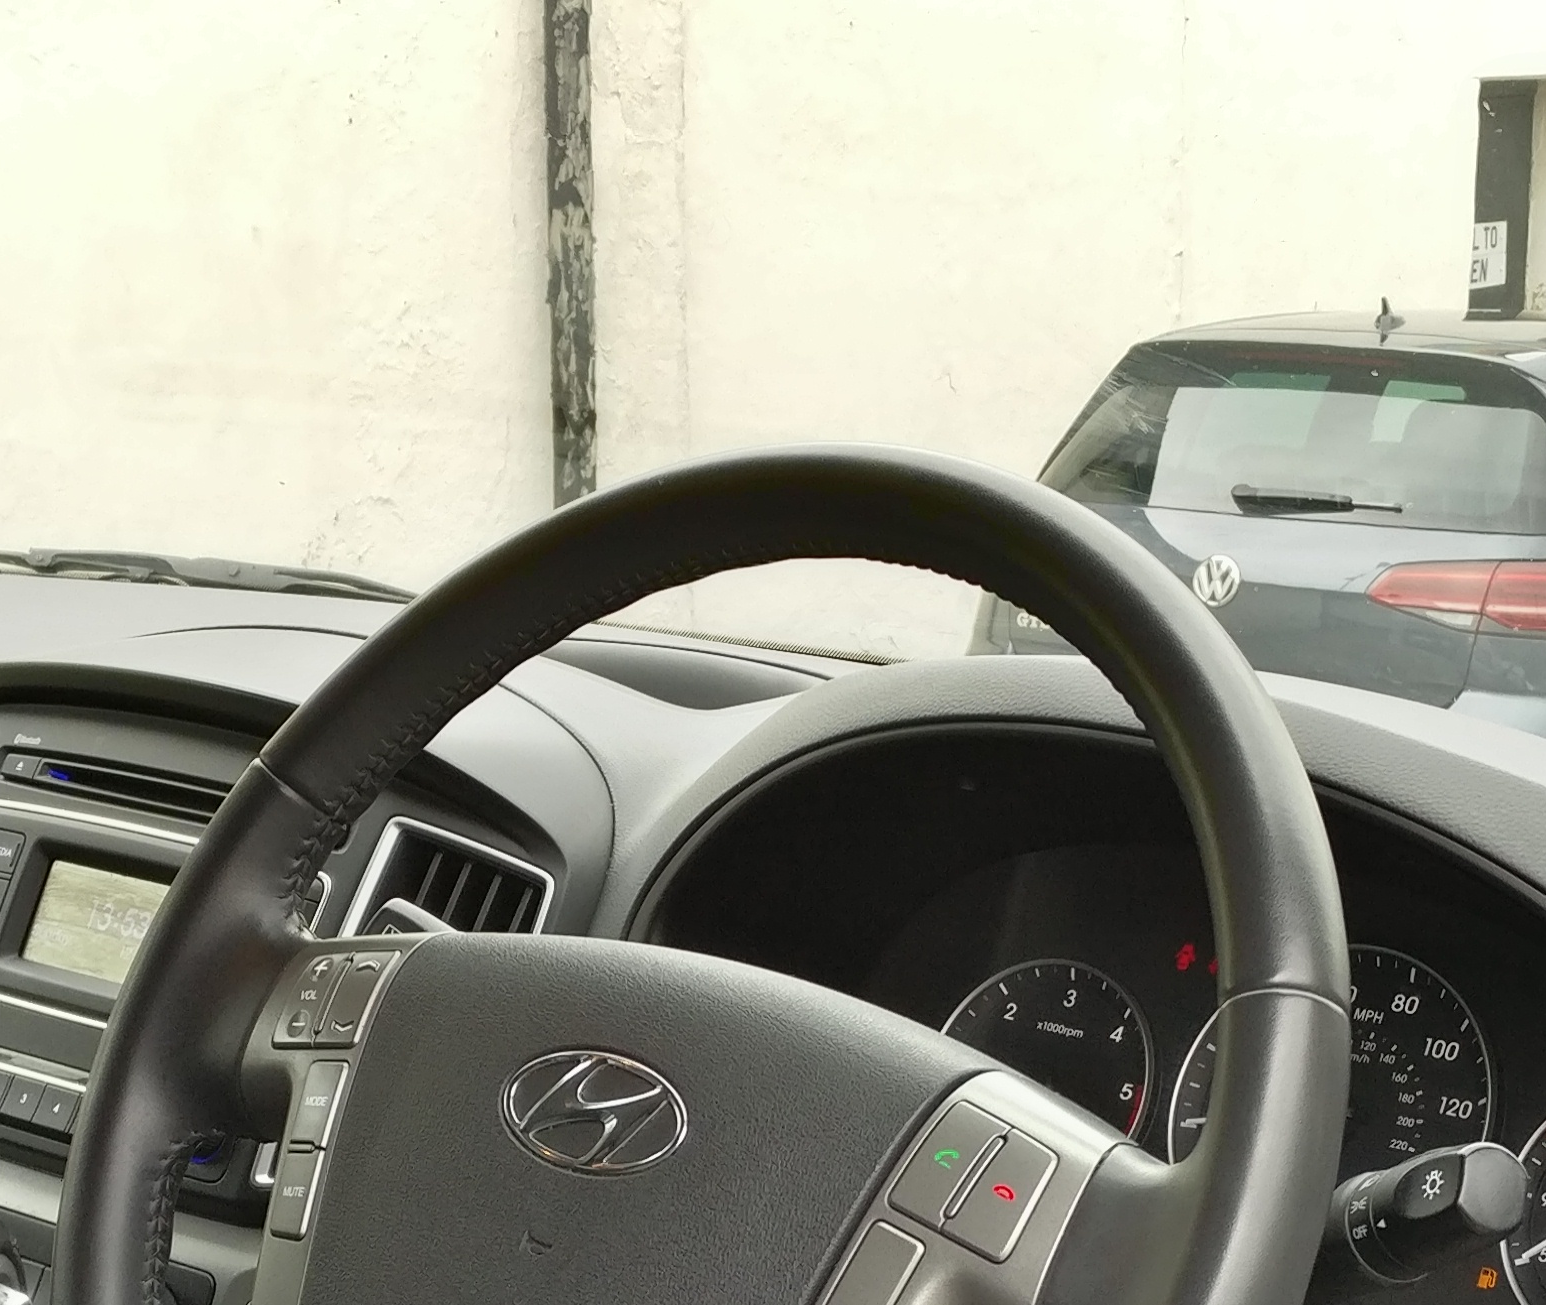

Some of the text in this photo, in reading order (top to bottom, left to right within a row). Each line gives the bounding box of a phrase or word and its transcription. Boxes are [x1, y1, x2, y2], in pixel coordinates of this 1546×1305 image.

[1484, 226, 1498, 250] TO
[299, 989, 319, 1001] VOL
[1062, 989, 1077, 1008] 3
[1390, 993, 1420, 1015] 80
[1003, 1002, 1018, 1021] 2
[1353, 1007, 1385, 1025] MPH
[1036, 1020, 1084, 1039] x1000rpm
[1109, 1026, 1125, 1043] 4
[1359, 1040, 1377, 1052] 120
[1423, 1037, 1460, 1061] 100
[1379, 1052, 1396, 1065] 140
[1391, 1071, 1408, 1084] 160
[19, 1093, 28, 1104] 3
[1119, 1083, 1134, 1101] 5
[1398, 1092, 1415, 1105] 180
[304, 1095, 329, 1107] MODE
[1439, 1096, 1473, 1120] 120
[52, 1103, 61, 1114] 4
[1395, 1115, 1415, 1128] 200
[1388, 1139, 1409, 1151] 220
[282, 1186, 305, 1198] MUTE
[1352, 1224, 1368, 1240] OFF
